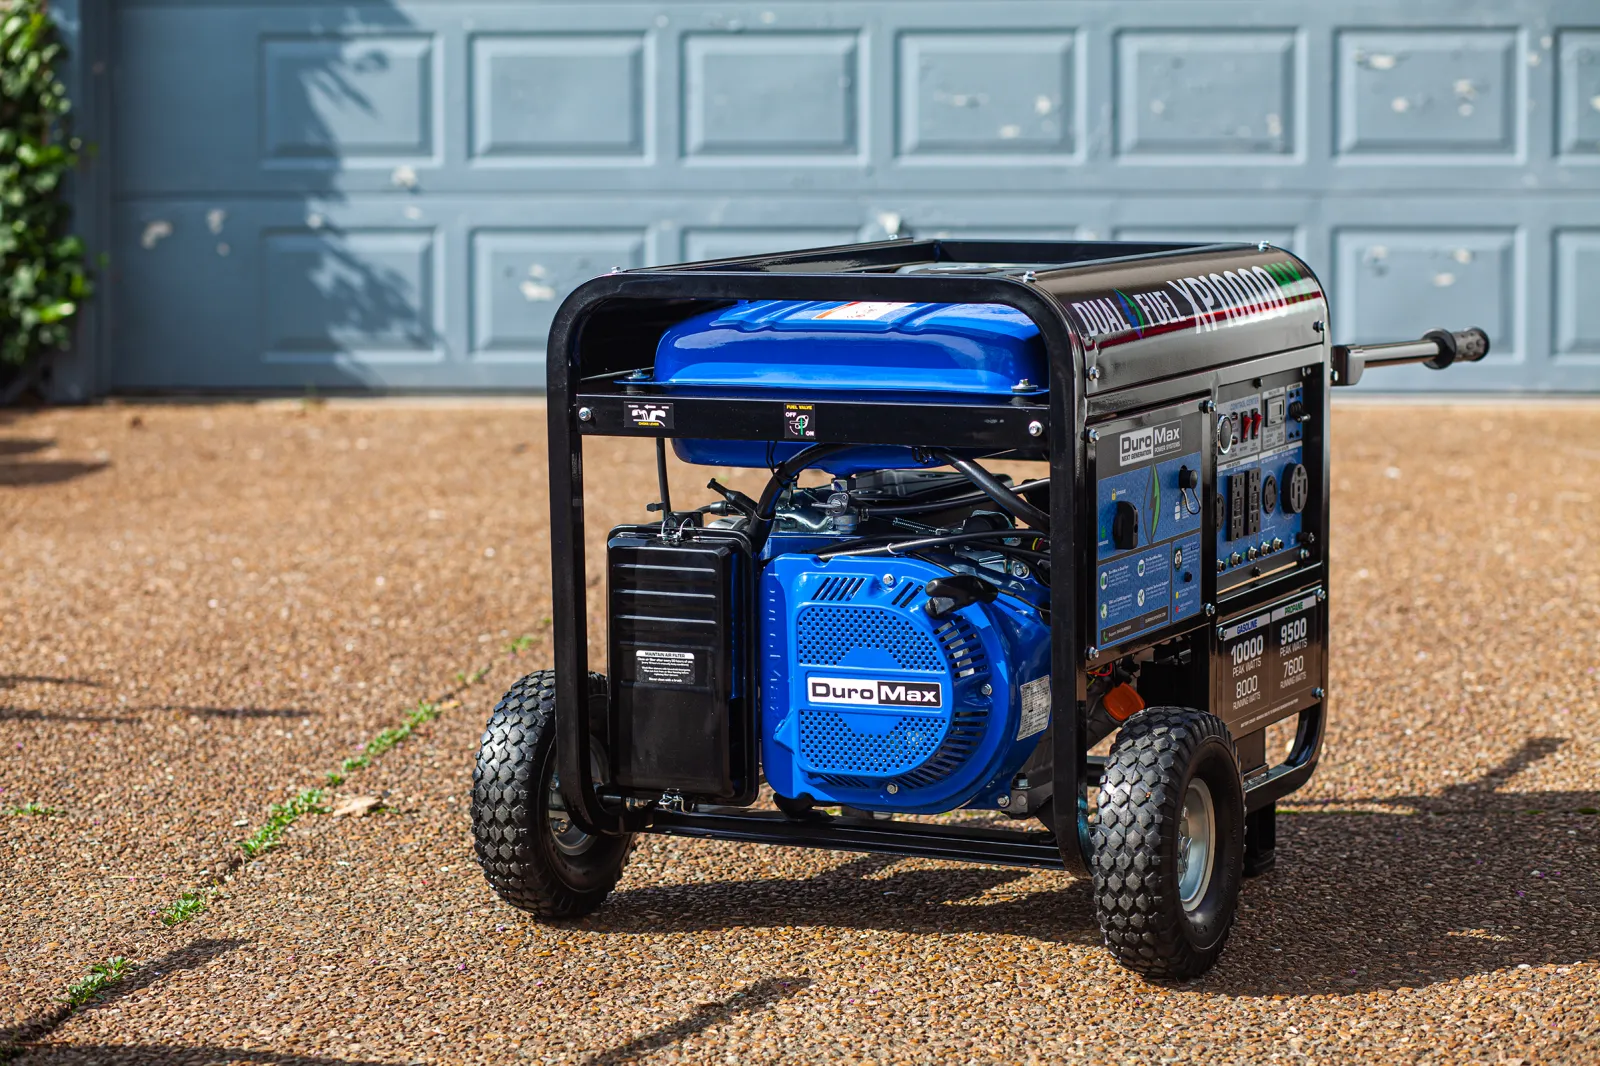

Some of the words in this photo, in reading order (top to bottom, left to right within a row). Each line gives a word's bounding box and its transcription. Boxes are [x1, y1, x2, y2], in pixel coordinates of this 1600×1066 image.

[1071, 297, 1132, 336] DUAL
[1132, 290, 1187, 327] FUEL
[1131, 449, 1152, 460] GENERATION
[1284, 602, 1304, 615] PROPANE
[1236, 619, 1258, 634] GASOLINE
[1280, 617, 1307, 646] 9500
[1230, 634, 1264, 666] 10000
[1280, 646, 1292, 658] PEAK
[1292, 638, 1308, 653] WATTS
[1232, 664, 1244, 678] PEAK
[1245, 657, 1262, 672] WATTS
[1283, 655, 1304, 678] 7600
[1236, 675, 1258, 698] 8000
[1280, 676, 1294, 689] RUNNING
[1232, 696, 1248, 710] RUNNING
[1249, 691, 1260, 703] WATTS
